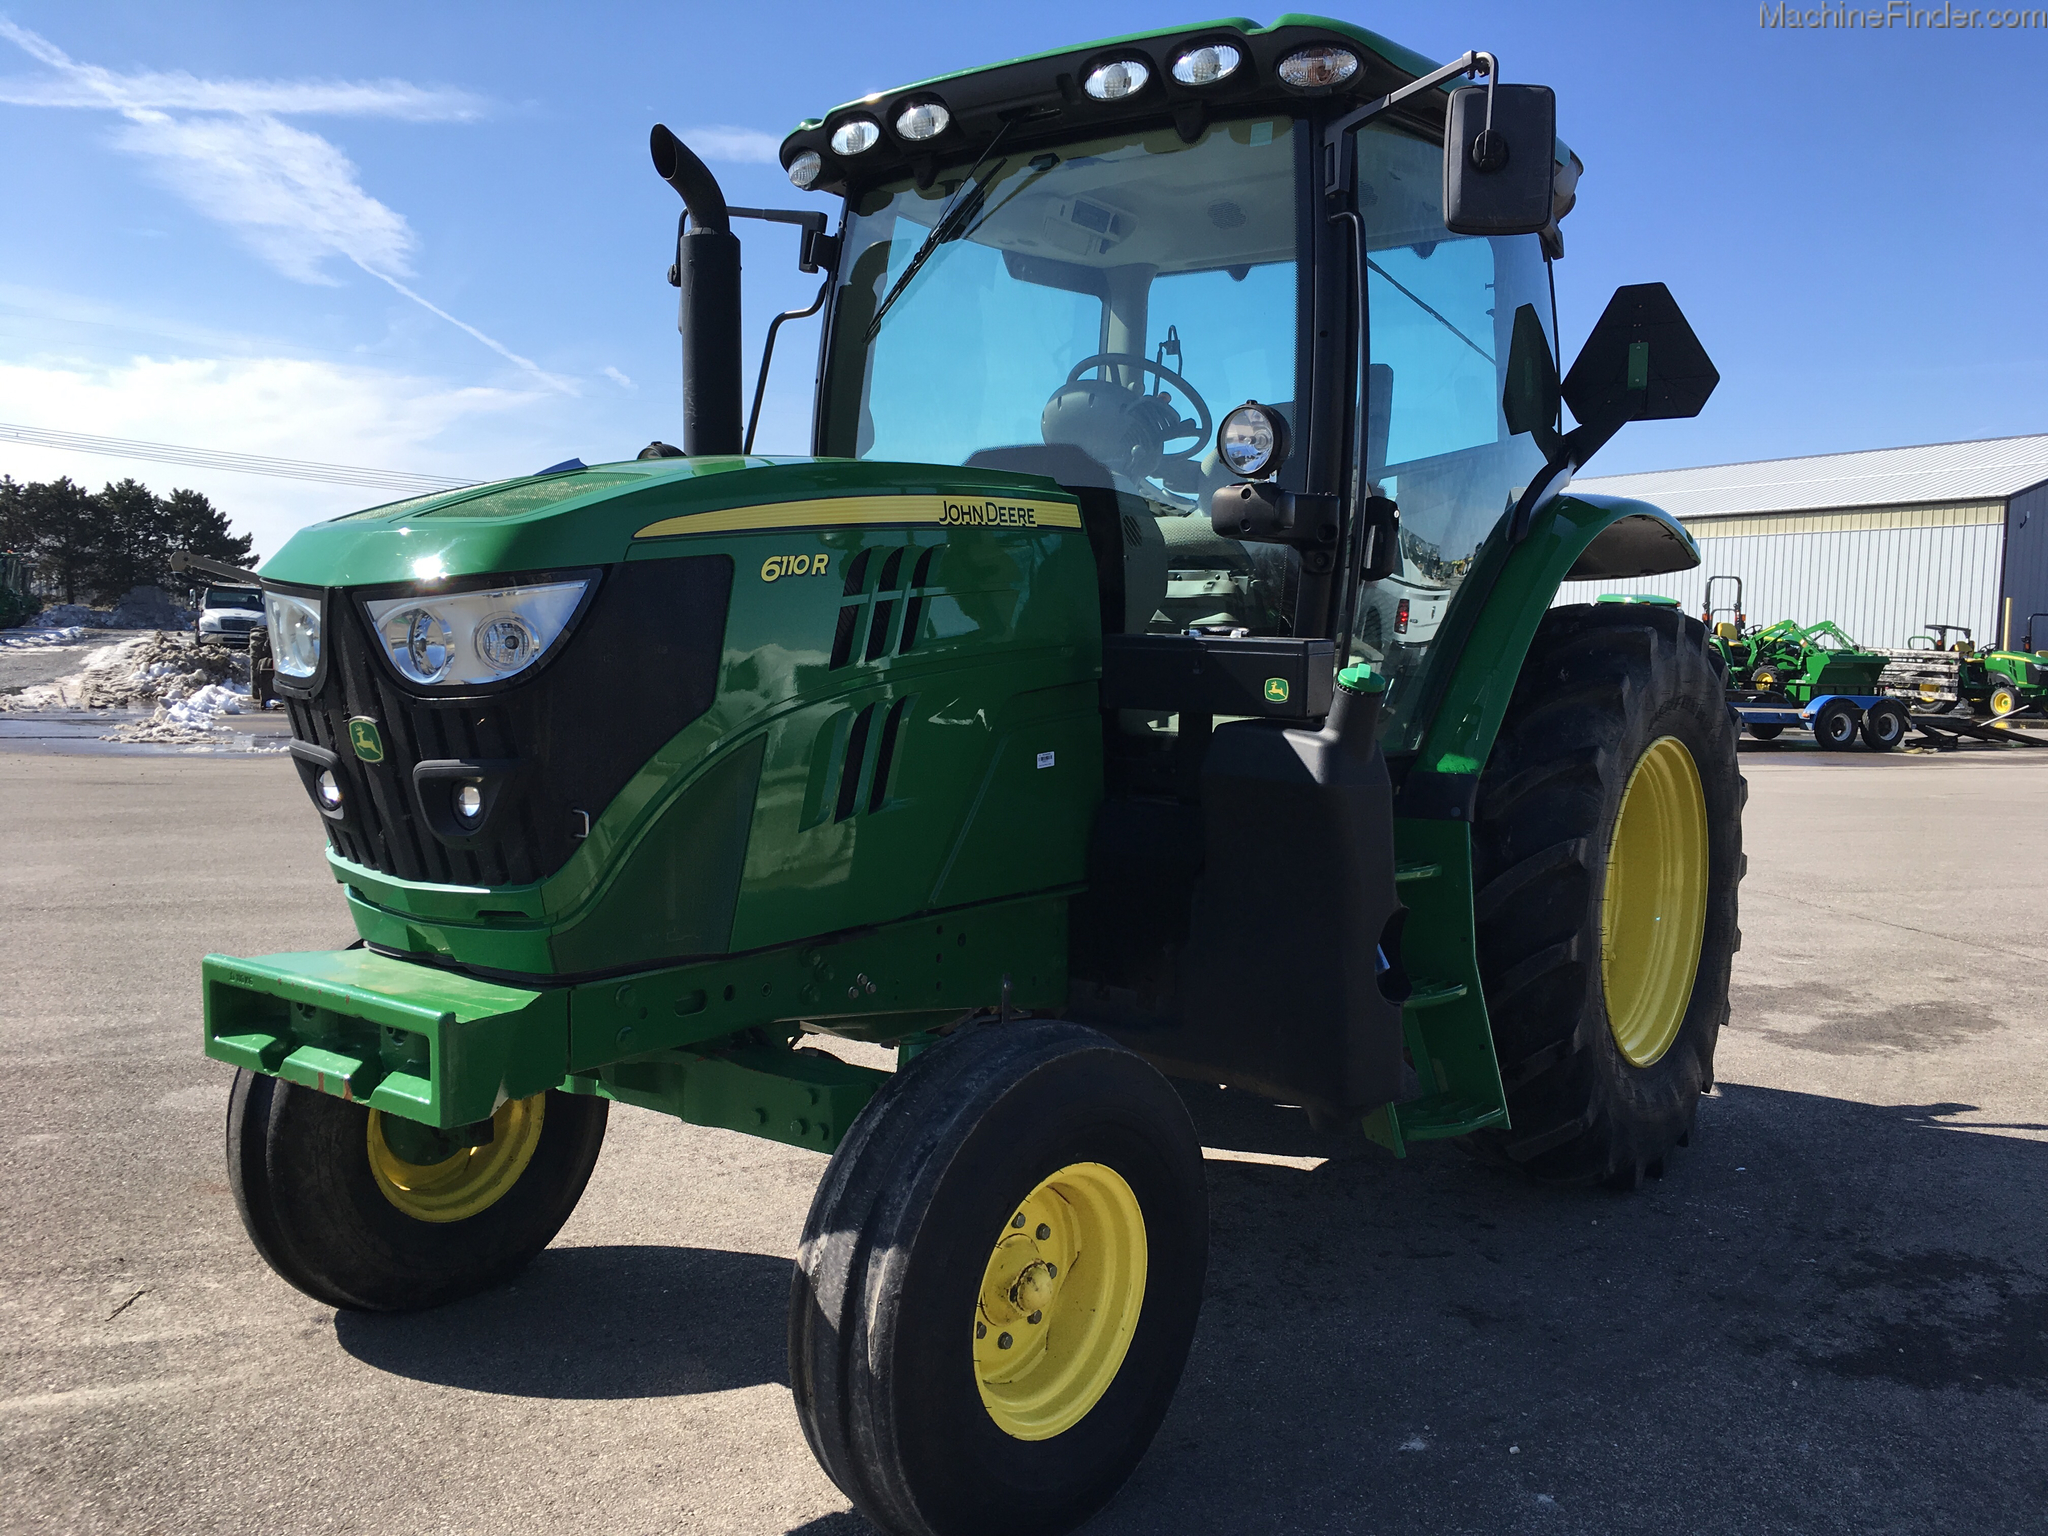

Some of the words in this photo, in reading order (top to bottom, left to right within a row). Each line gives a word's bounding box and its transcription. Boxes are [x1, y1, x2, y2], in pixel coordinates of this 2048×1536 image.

[939, 500, 984, 524] JOHN
[985, 501, 1037, 527] DEERE
[760, 553, 829, 583] 6110R
